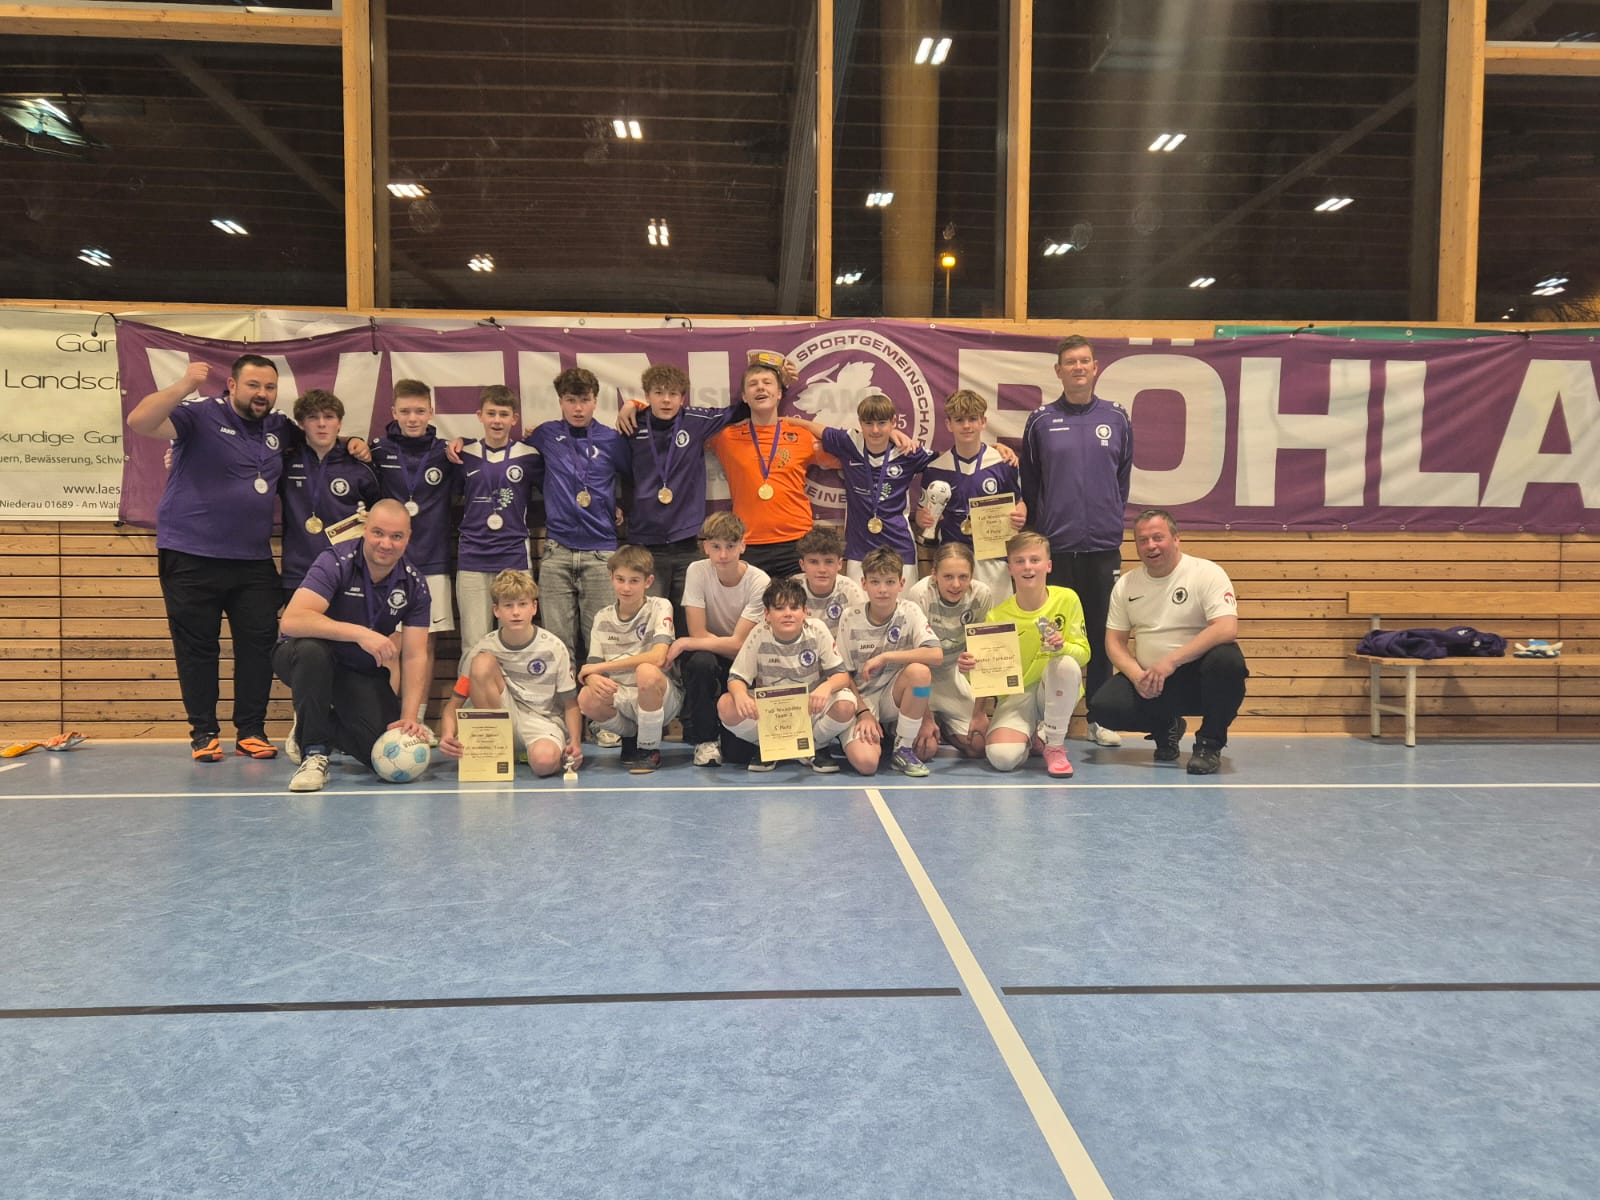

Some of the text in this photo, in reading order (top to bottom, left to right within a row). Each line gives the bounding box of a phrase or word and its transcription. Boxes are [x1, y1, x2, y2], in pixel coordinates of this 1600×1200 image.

[796, 335, 930, 447] SPORTGEMEINSCHAF
[24, 454, 93, 466] Bewässerung,
[0, 499, 42, 508] Niederau
[45, 500, 74, 508] 01689
